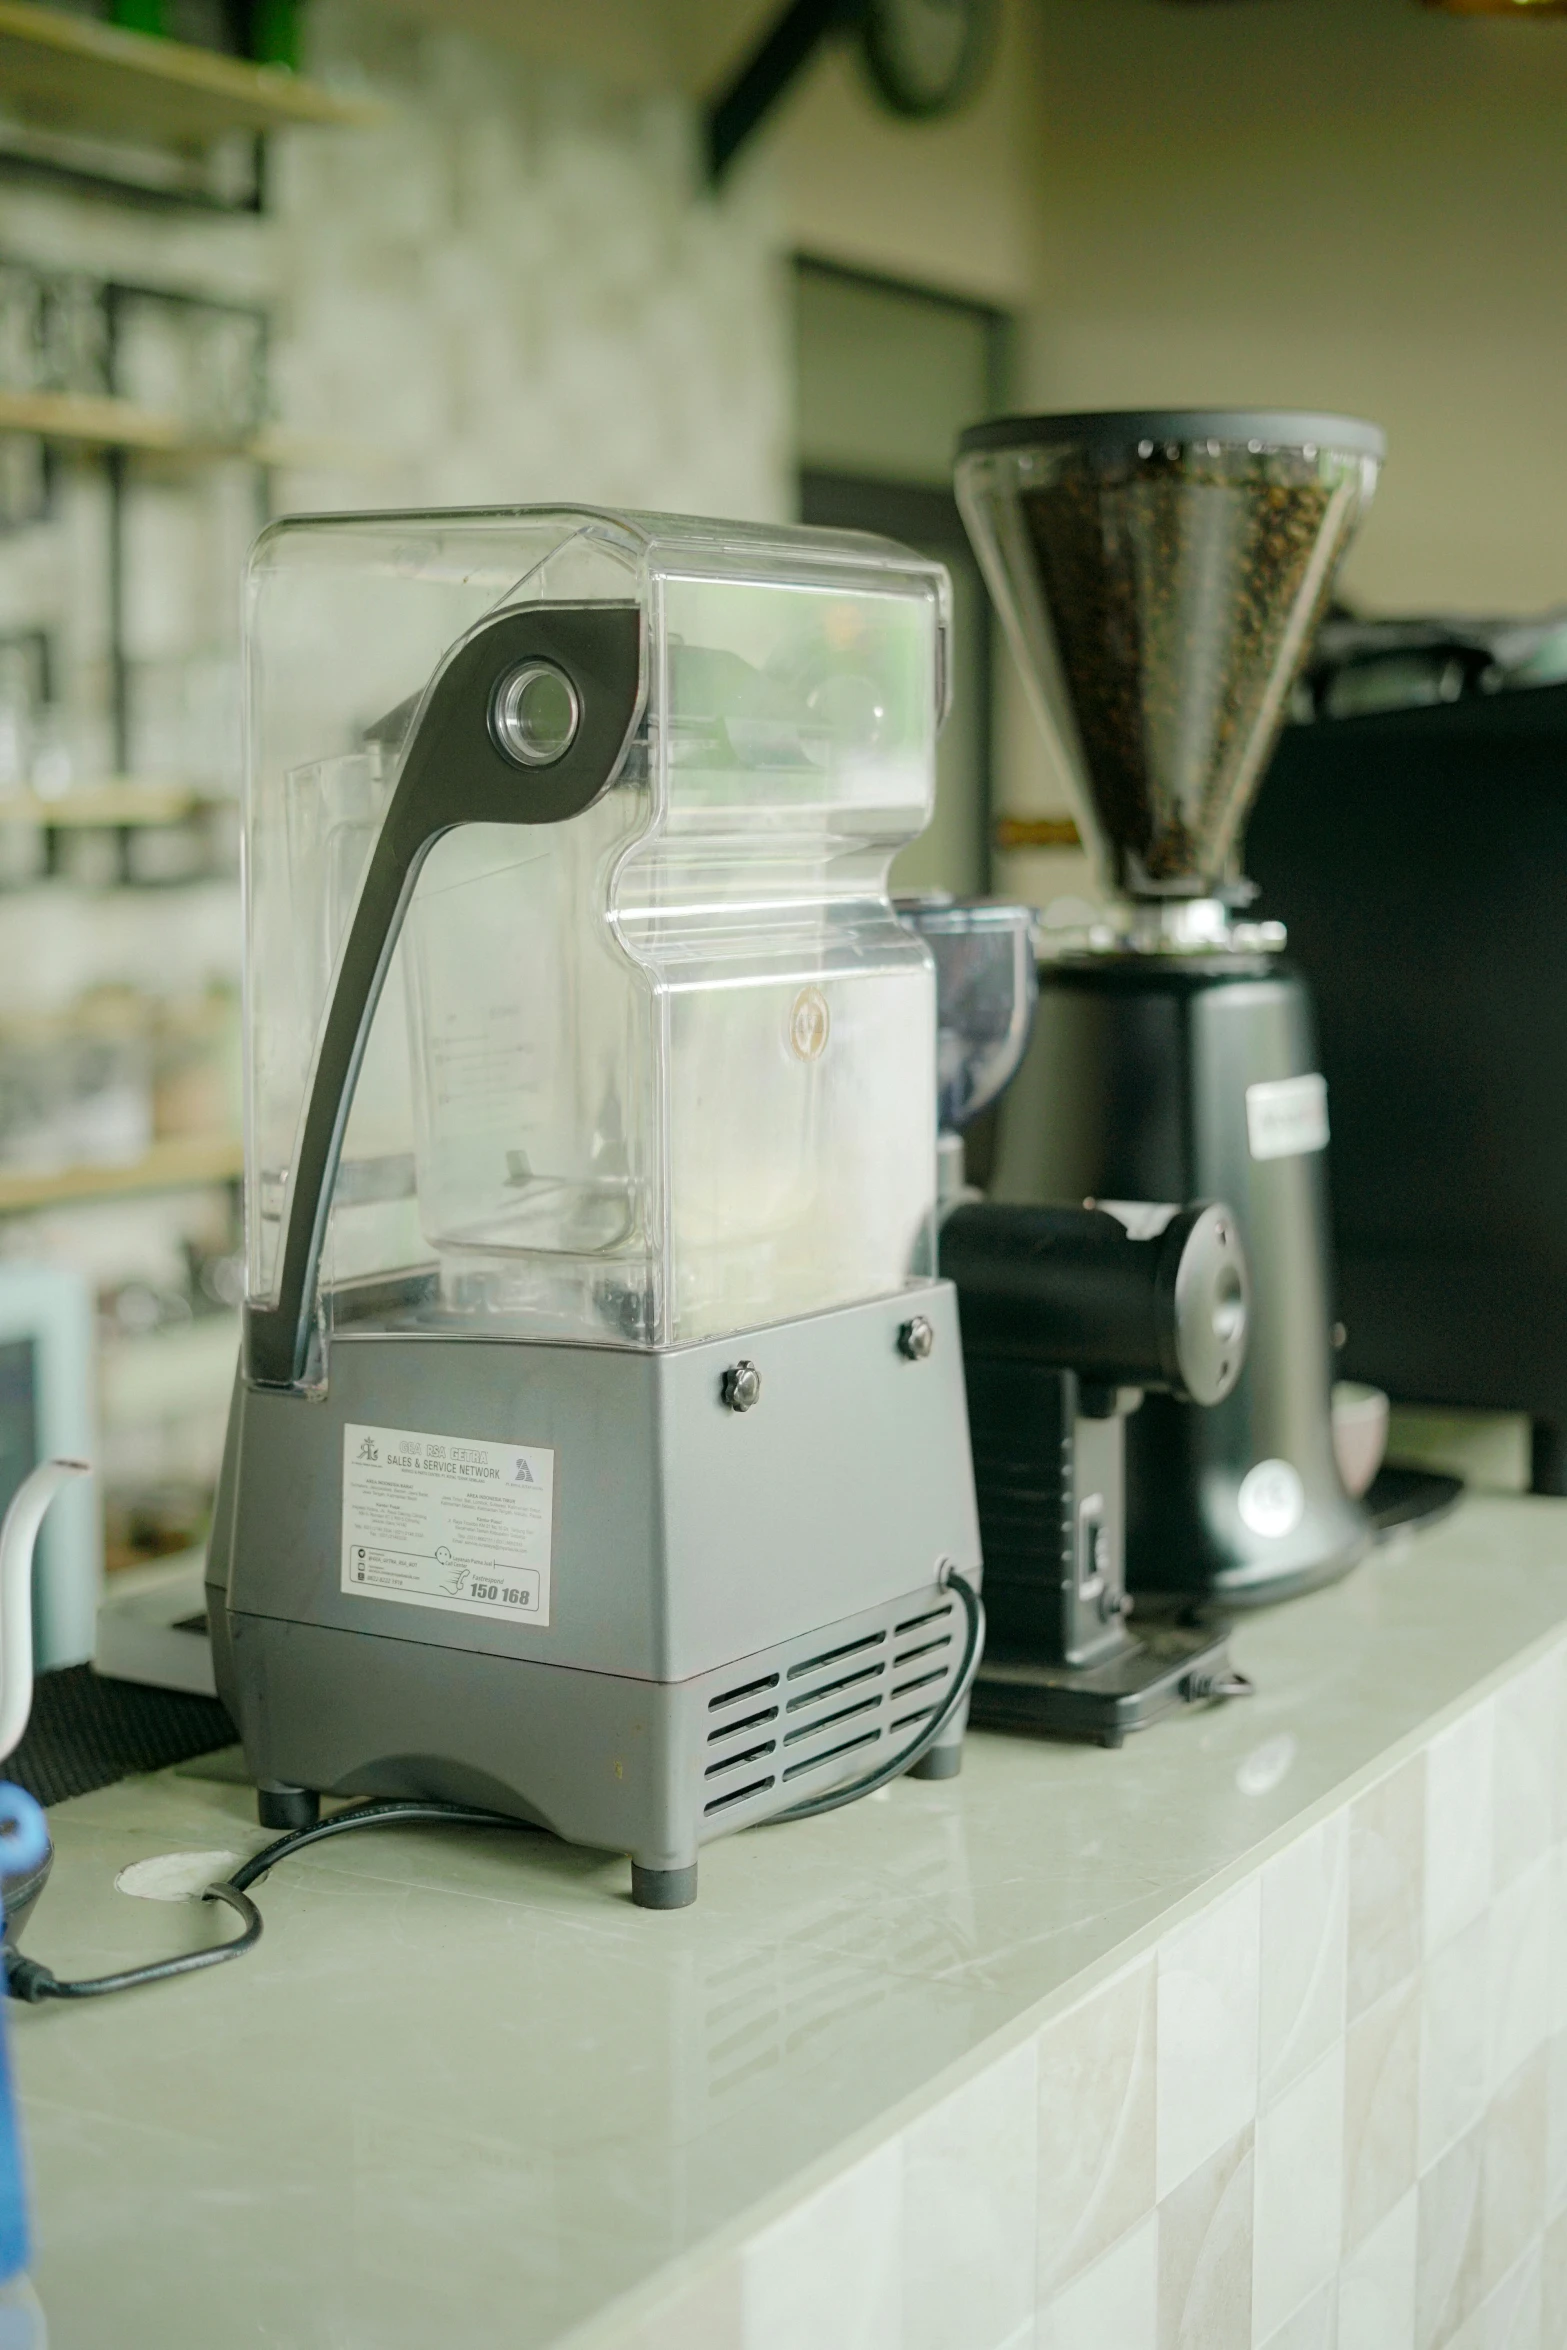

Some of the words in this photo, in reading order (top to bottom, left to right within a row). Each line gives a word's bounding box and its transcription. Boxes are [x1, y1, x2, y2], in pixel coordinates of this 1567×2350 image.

[400, 1441, 422, 1456] GEA
[426, 1444, 446, 1459] RSA
[451, 1447, 488, 1464] GETRA
[388, 1455, 411, 1467] SALES
[415, 1458, 420, 1469] &
[424, 1460, 457, 1473] SERVICE
[460, 1464, 500, 1479] NETWORK
[453, 1556, 470, 1564] Layanan
[472, 1575, 504, 1585] Fastrespond
[471, 1583, 497, 1600] 150
[502, 1588, 530, 1606] 168
